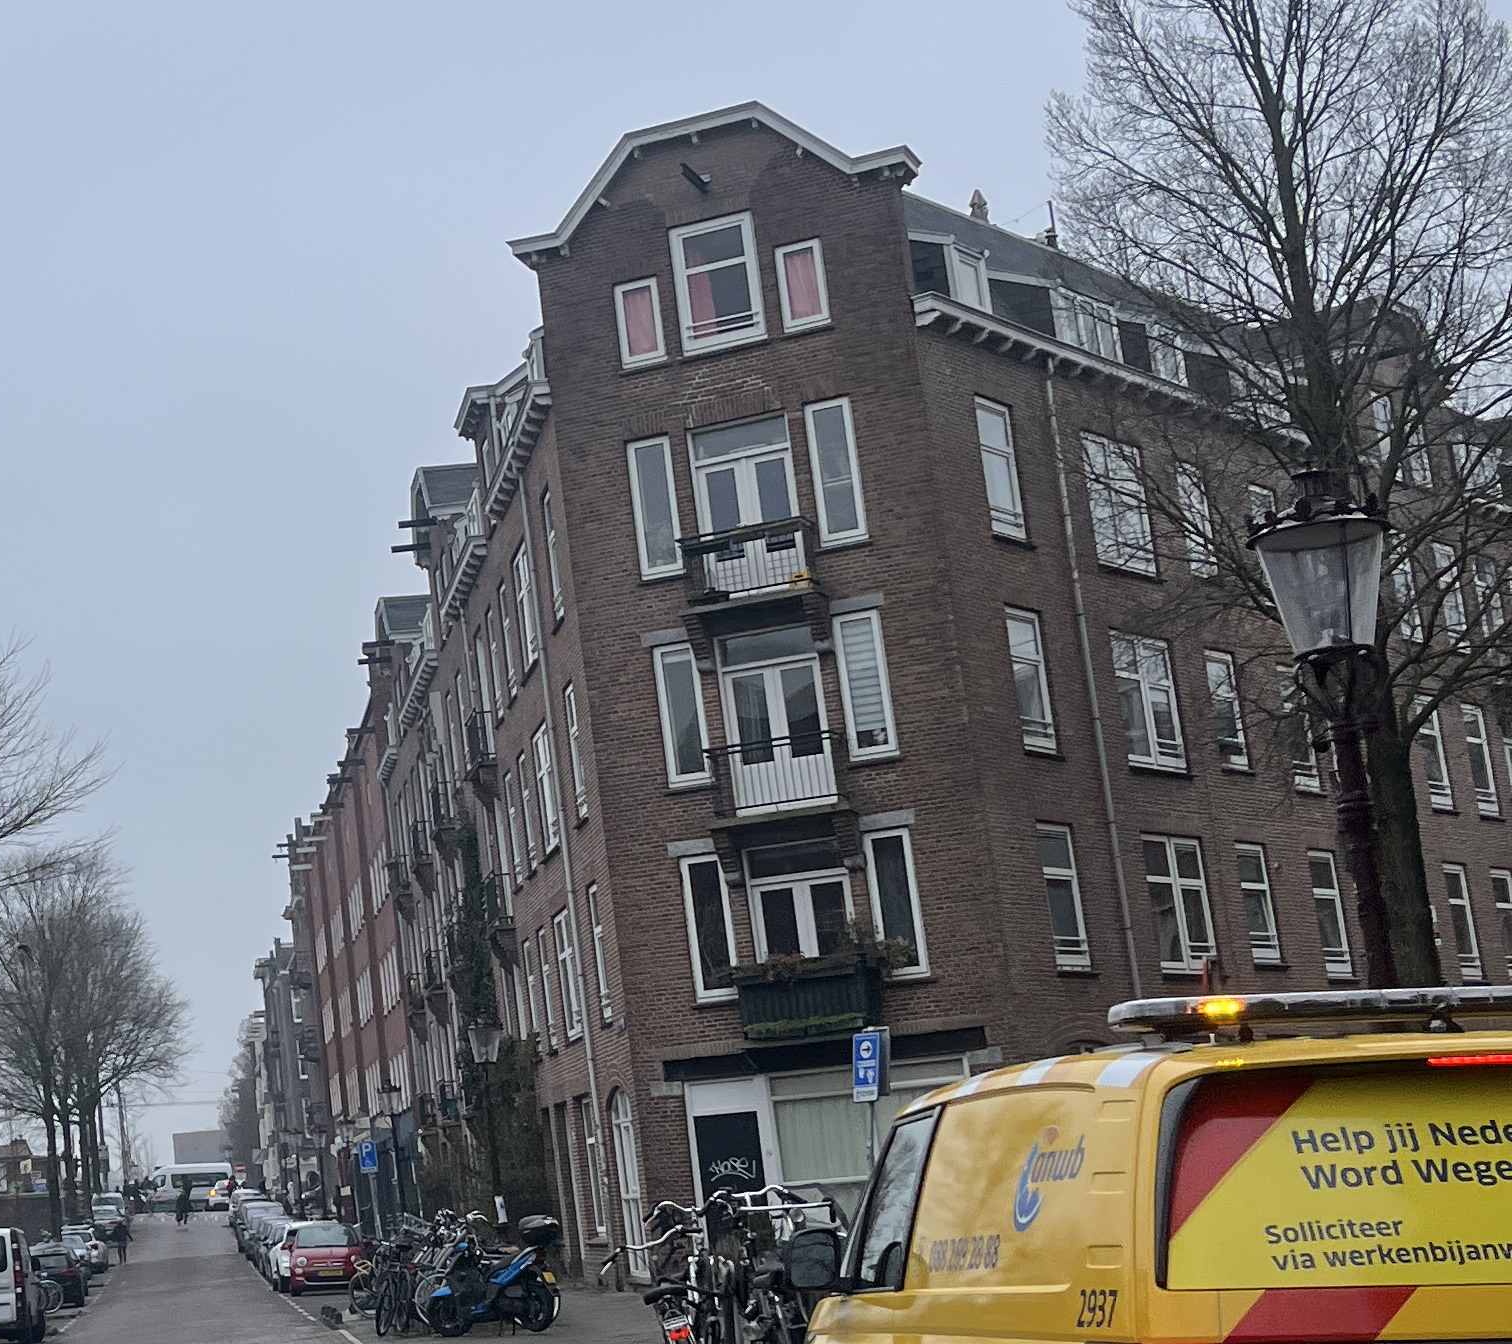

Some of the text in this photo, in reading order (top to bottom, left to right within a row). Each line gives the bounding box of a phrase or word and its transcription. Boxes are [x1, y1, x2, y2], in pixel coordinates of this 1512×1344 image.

[362, 1142, 372, 1157] P
[1291, 1126, 1375, 1155] Help
[1384, 1122, 1420, 1154] jij
[1029, 1134, 1086, 1185] anwb
[1301, 1159, 1403, 1190] Word
[1264, 1219, 1403, 1244] Solliciteer
[1271, 1249, 1316, 1271] via
[1076, 1289, 1118, 1328] 2937
